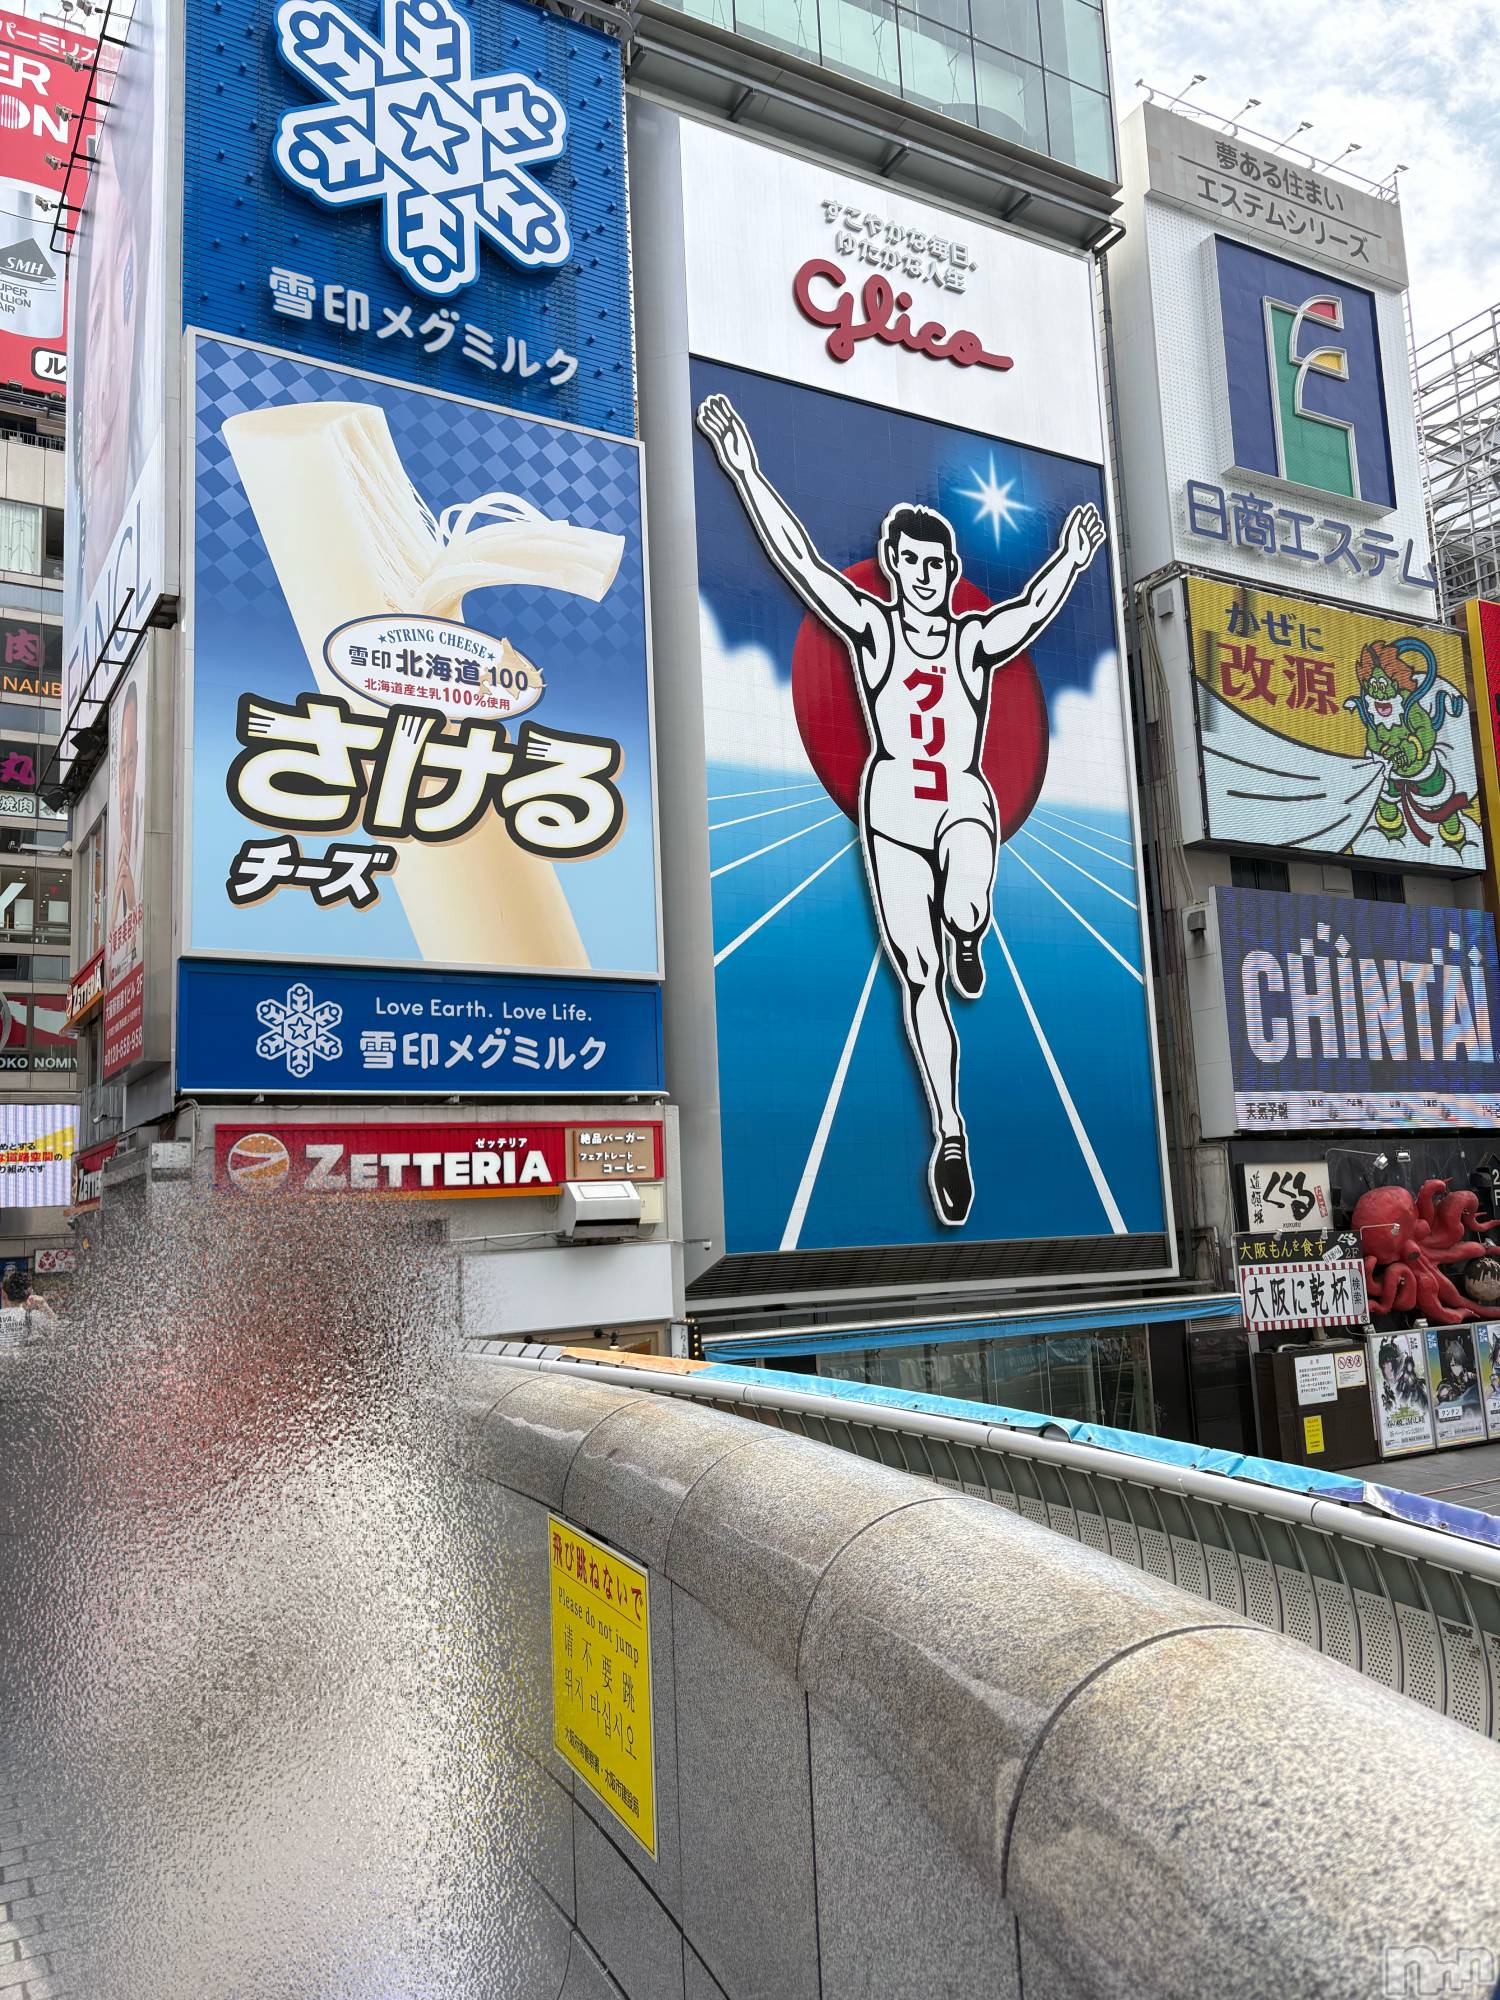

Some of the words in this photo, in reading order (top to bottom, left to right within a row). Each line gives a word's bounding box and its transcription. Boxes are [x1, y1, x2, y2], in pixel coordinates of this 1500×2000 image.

[1215, 140, 1344, 211] 夢ある住まい
[1197, 174, 1369, 263] エステムシリーズ
[5, 256, 44, 275] SMH
[269, 266, 579, 386] 雪印メグミルク
[794, 258, 1014, 370] Glico
[1186, 479, 1438, 591] 日商エステム
[4, 628, 44, 669] 肉
[66, 499, 152, 757] FANCL
[387, 628, 435, 644] STRING
[439, 631, 488, 660] CHEESE
[1225, 602, 1325, 652] かぜに
[364, 678, 511, 710] 北海道産生乳100%使用
[1216, 642, 1340, 716] 改源
[902, 665, 949, 802] グリコ
[230, 694, 622, 856] さける
[228, 837, 396, 905] チーズ
[376, 997, 424, 1016] Love
[431, 998, 493, 1018] Earth.
[503, 1002, 546, 1020] Love
[553, 1003, 592, 1022] Life.
[359, 1027, 607, 1070] 雪印メグミルク
[475, 1137, 528, 1149] ゼッテリア
[580, 1132, 646, 1145] 絶品バーガー
[580, 1152, 633, 1161] フェアトレード
[303, 1144, 553, 1188] ZETTERIA
[603, 1163, 647, 1173] コーヒー
[1262, 1171, 1316, 1221] くくる
[1239, 1238, 1327, 1260] 大阪もんを食す
[1344, 1247, 1360, 1259] 2F
[1248, 1272, 1350, 1320] 大阪に乾杯
[552, 1531, 644, 1622] 飛び跳ねないで
[558, 1586, 583, 1619] Please
[585, 1606, 596, 1629] do
[598, 1621, 613, 1644] not
[615, 1629, 639, 1669] jump
